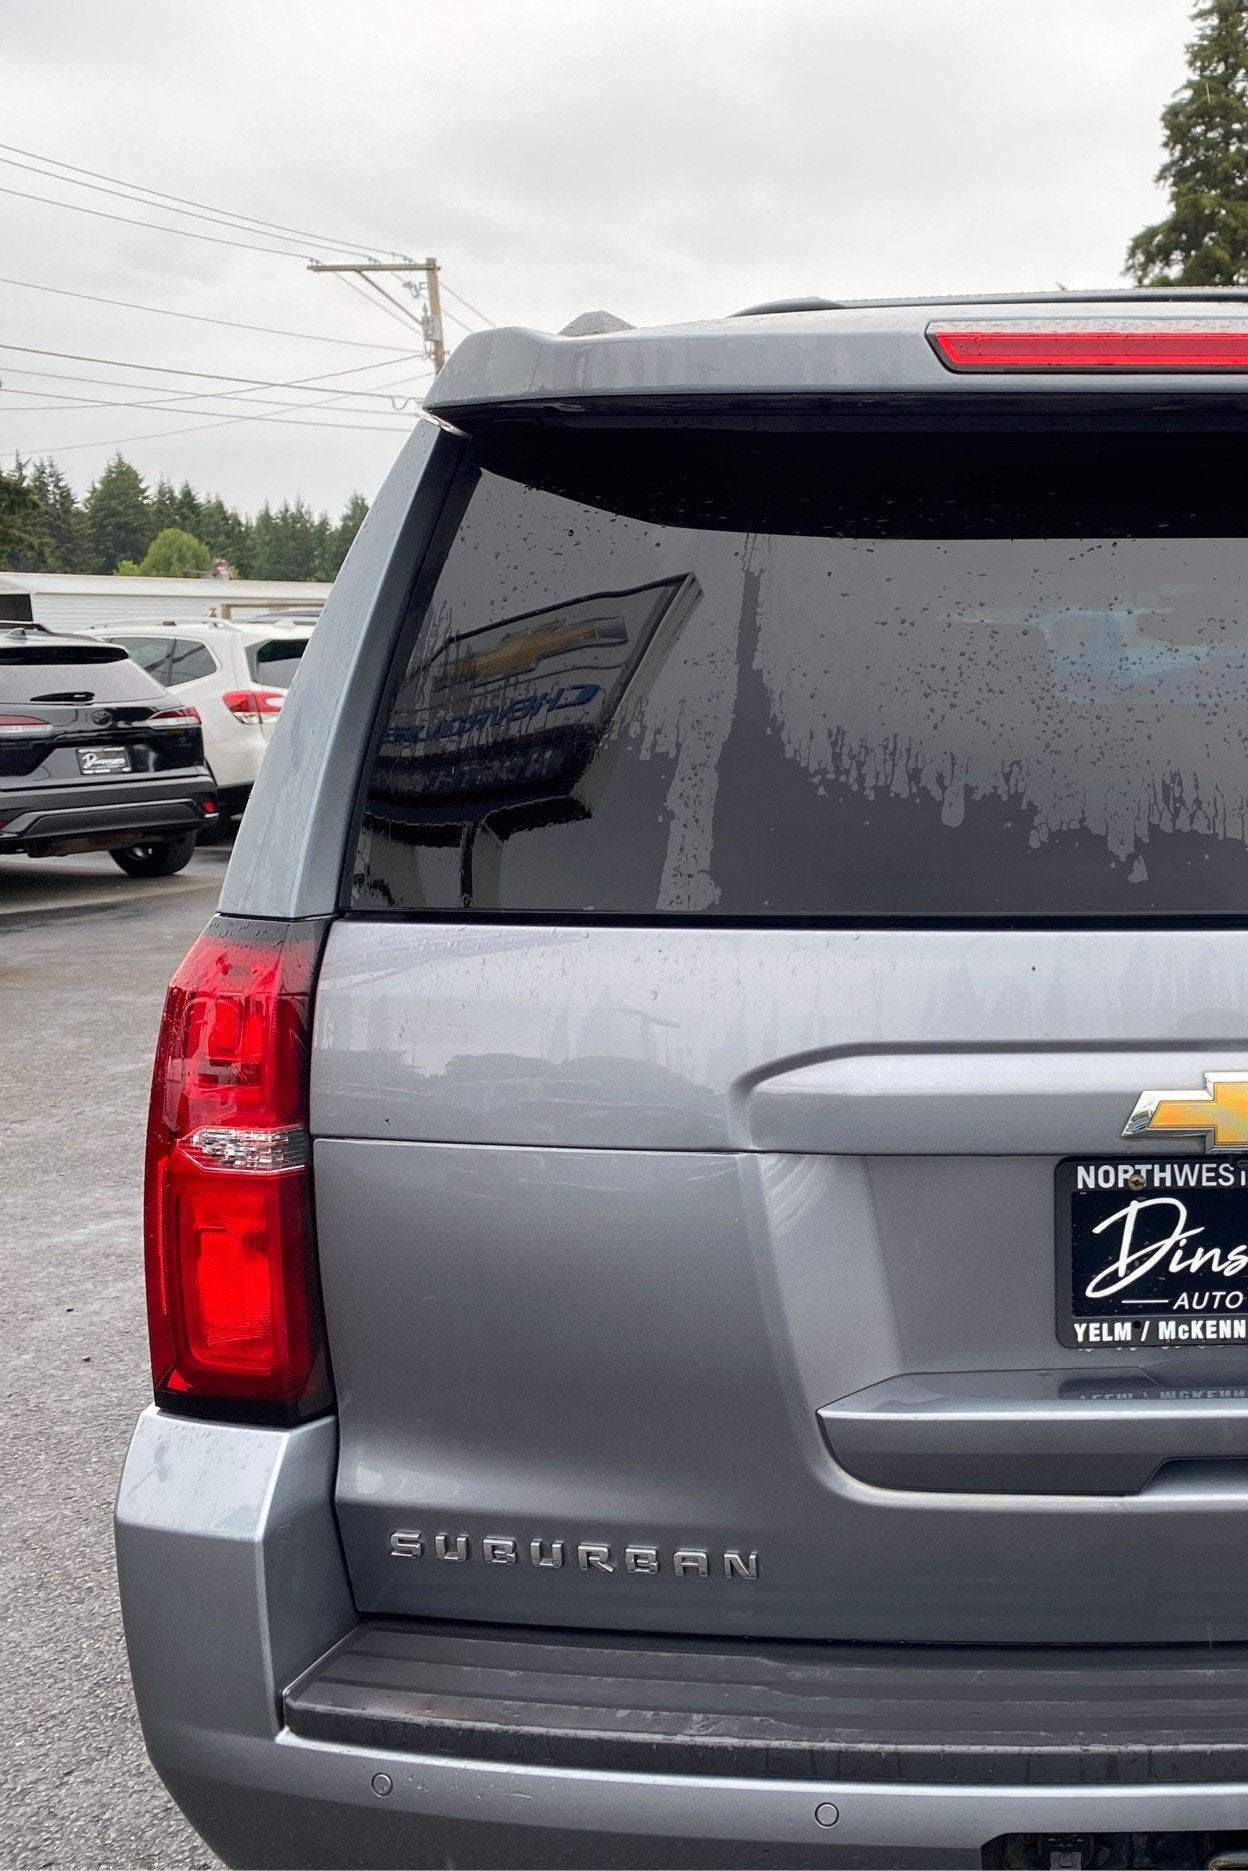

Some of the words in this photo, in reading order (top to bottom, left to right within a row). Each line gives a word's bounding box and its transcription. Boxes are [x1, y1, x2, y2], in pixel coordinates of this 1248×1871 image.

[1173, 1291, 1244, 1310] AUTO
[1074, 1321, 1132, 1342] YELM
[1141, 1321, 1150, 1341] /
[389, 1529, 760, 1580] SUBURBAN
